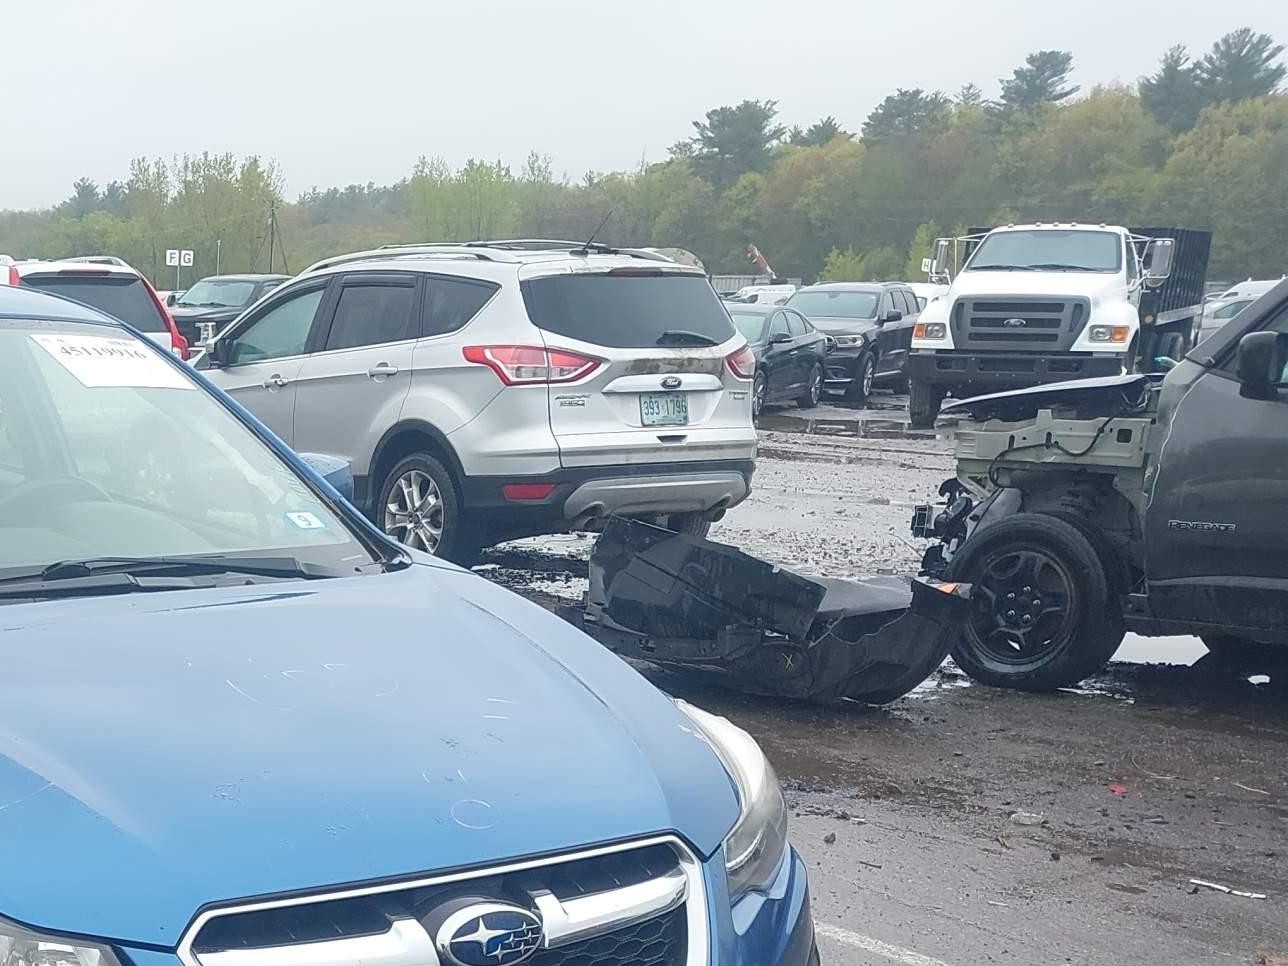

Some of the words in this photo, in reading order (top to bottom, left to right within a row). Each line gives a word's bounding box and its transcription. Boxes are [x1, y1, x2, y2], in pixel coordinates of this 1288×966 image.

[169, 252, 177, 263] F
[183, 253, 192, 263] G
[60, 345, 148, 360] 45119916
[643, 400, 661, 416] 393
[665, 399, 687, 416] 1796
